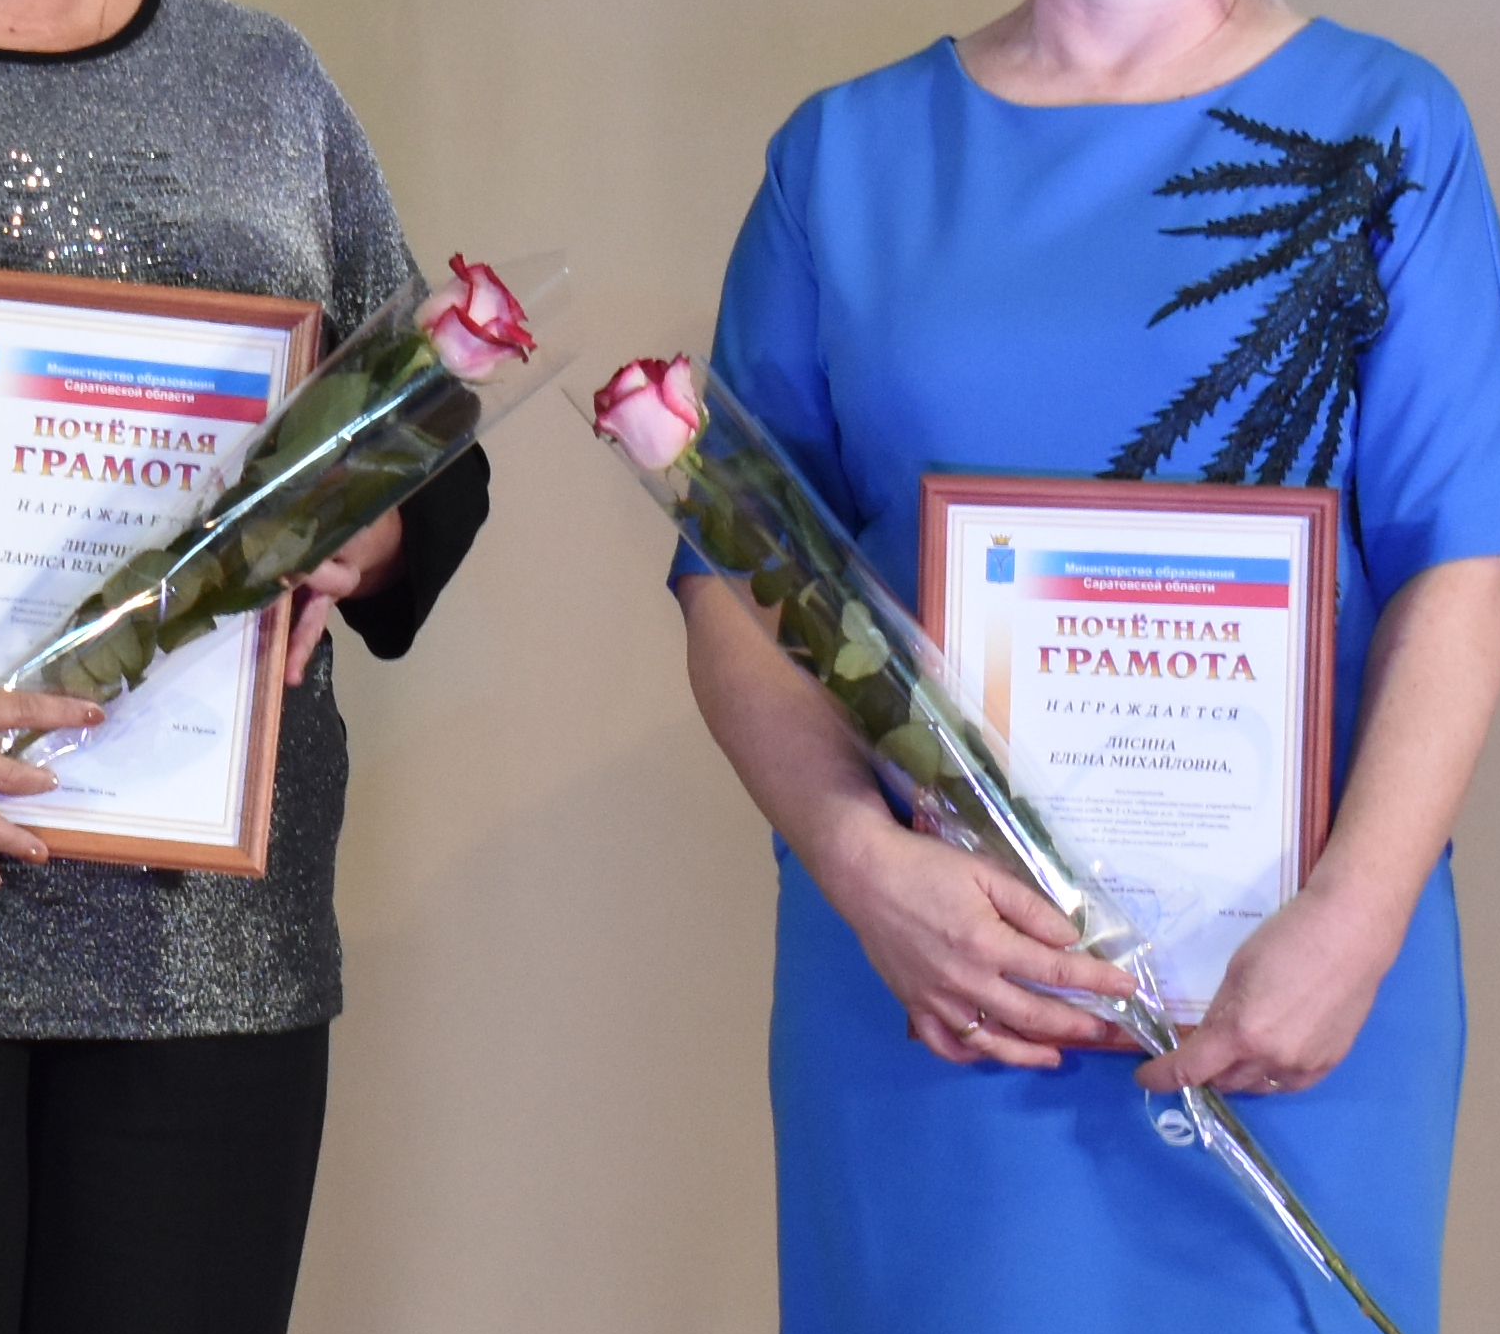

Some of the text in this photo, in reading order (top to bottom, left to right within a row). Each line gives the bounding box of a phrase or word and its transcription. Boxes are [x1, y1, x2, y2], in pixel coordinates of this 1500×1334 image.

[46, 362, 216, 392] Министерство образования
[63, 378, 196, 405] Саратовской области
[33, 414, 218, 456] ПОЧЁТНАЯ
[0, 549, 66, 570] ЛАРИСА
[1064, 563, 1236, 580] Министерство образования
[1083, 576, 1216, 594] Саратовской области
[1056, 613, 1241, 643] ПОЧЁТНАЯ
[1038, 646, 1257, 682] ГРАМОТА
[1045, 698, 1240, 722] НАГРАЖДАЕТСЯ
[1105, 735, 1177, 752] ЛИСИНА
[1049, 751, 1233, 774] ЕЛЕНА МИХАЙЛОВНА,
